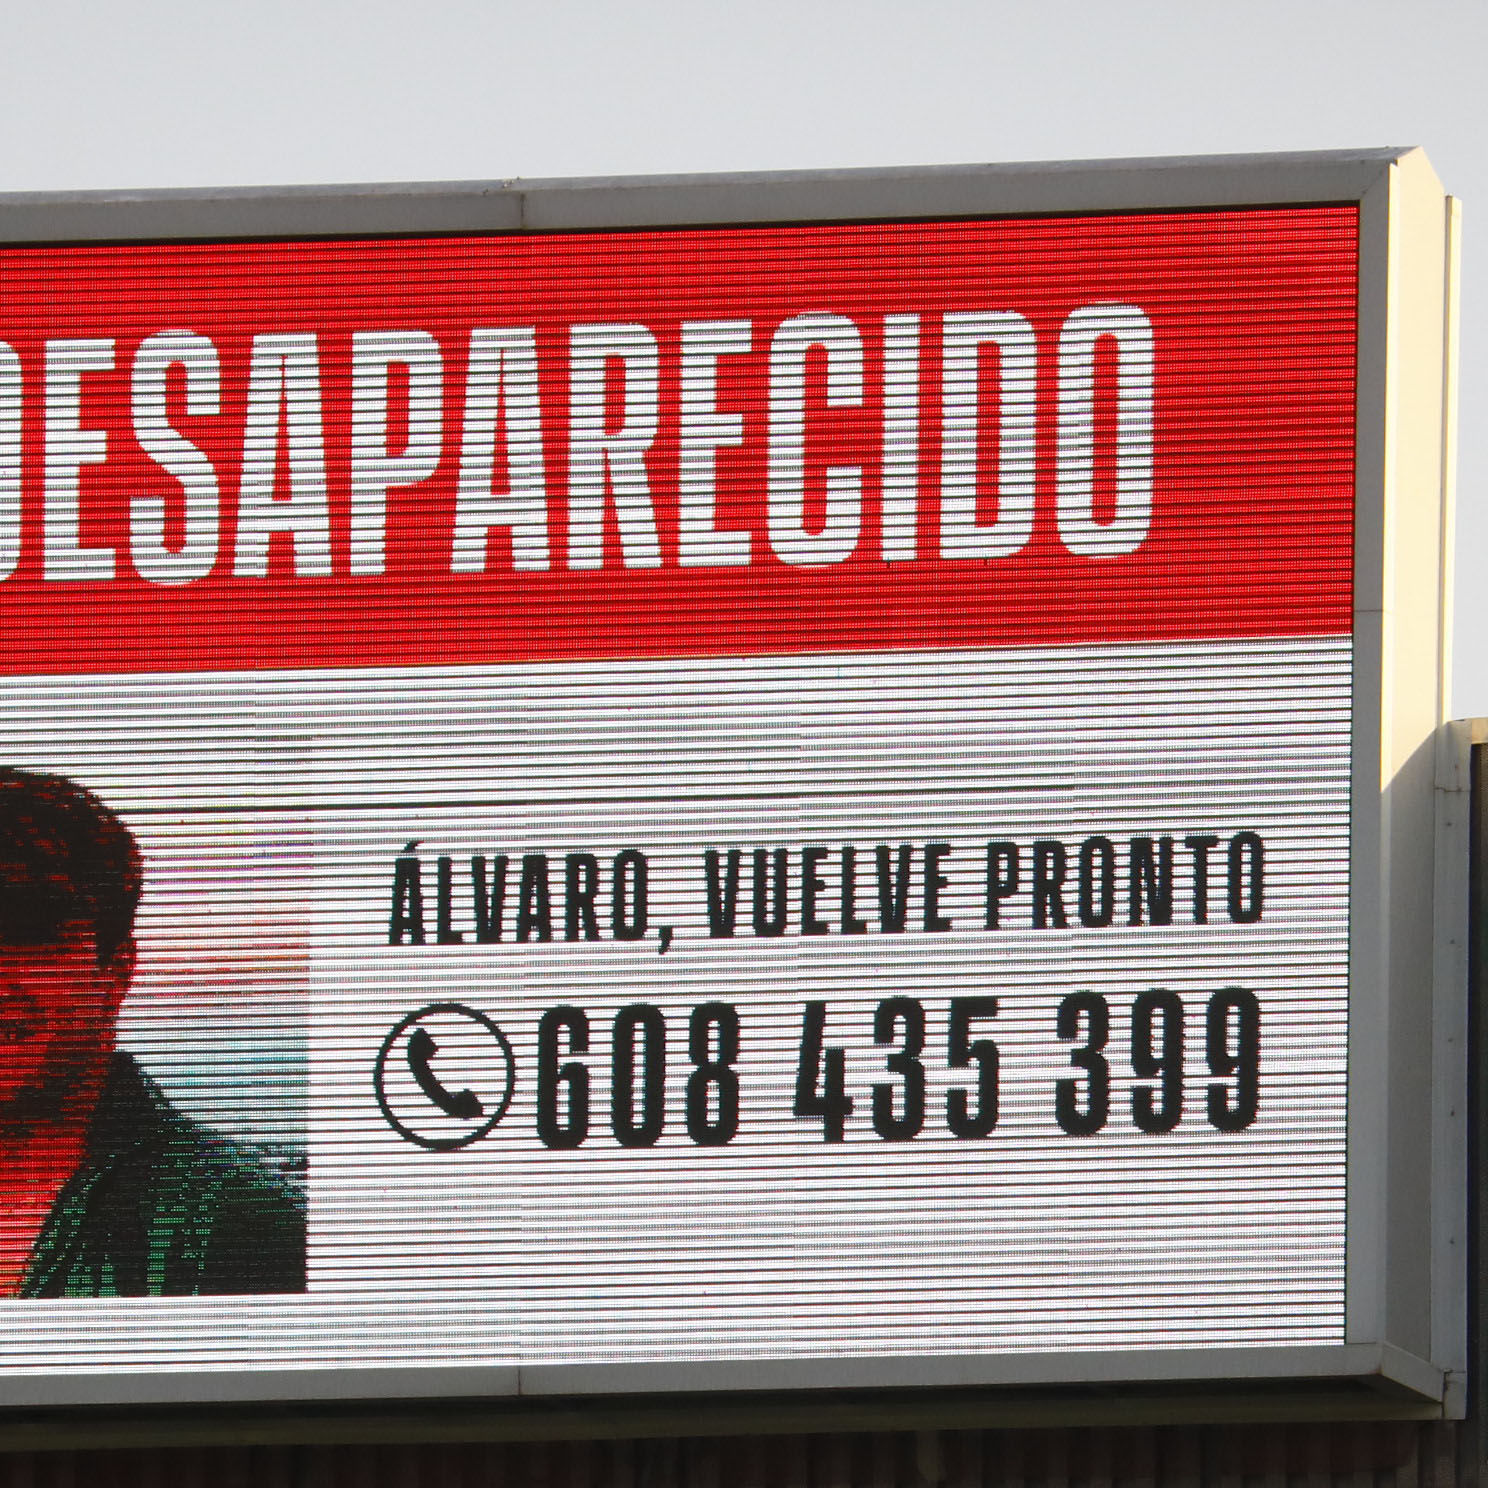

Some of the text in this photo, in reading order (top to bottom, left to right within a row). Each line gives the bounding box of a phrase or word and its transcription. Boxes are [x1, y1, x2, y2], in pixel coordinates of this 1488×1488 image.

[388, 830, 1264, 955] ÁLVARO, VUELVE PRONTO
[537, 986, 1260, 1149] 608 435 399
